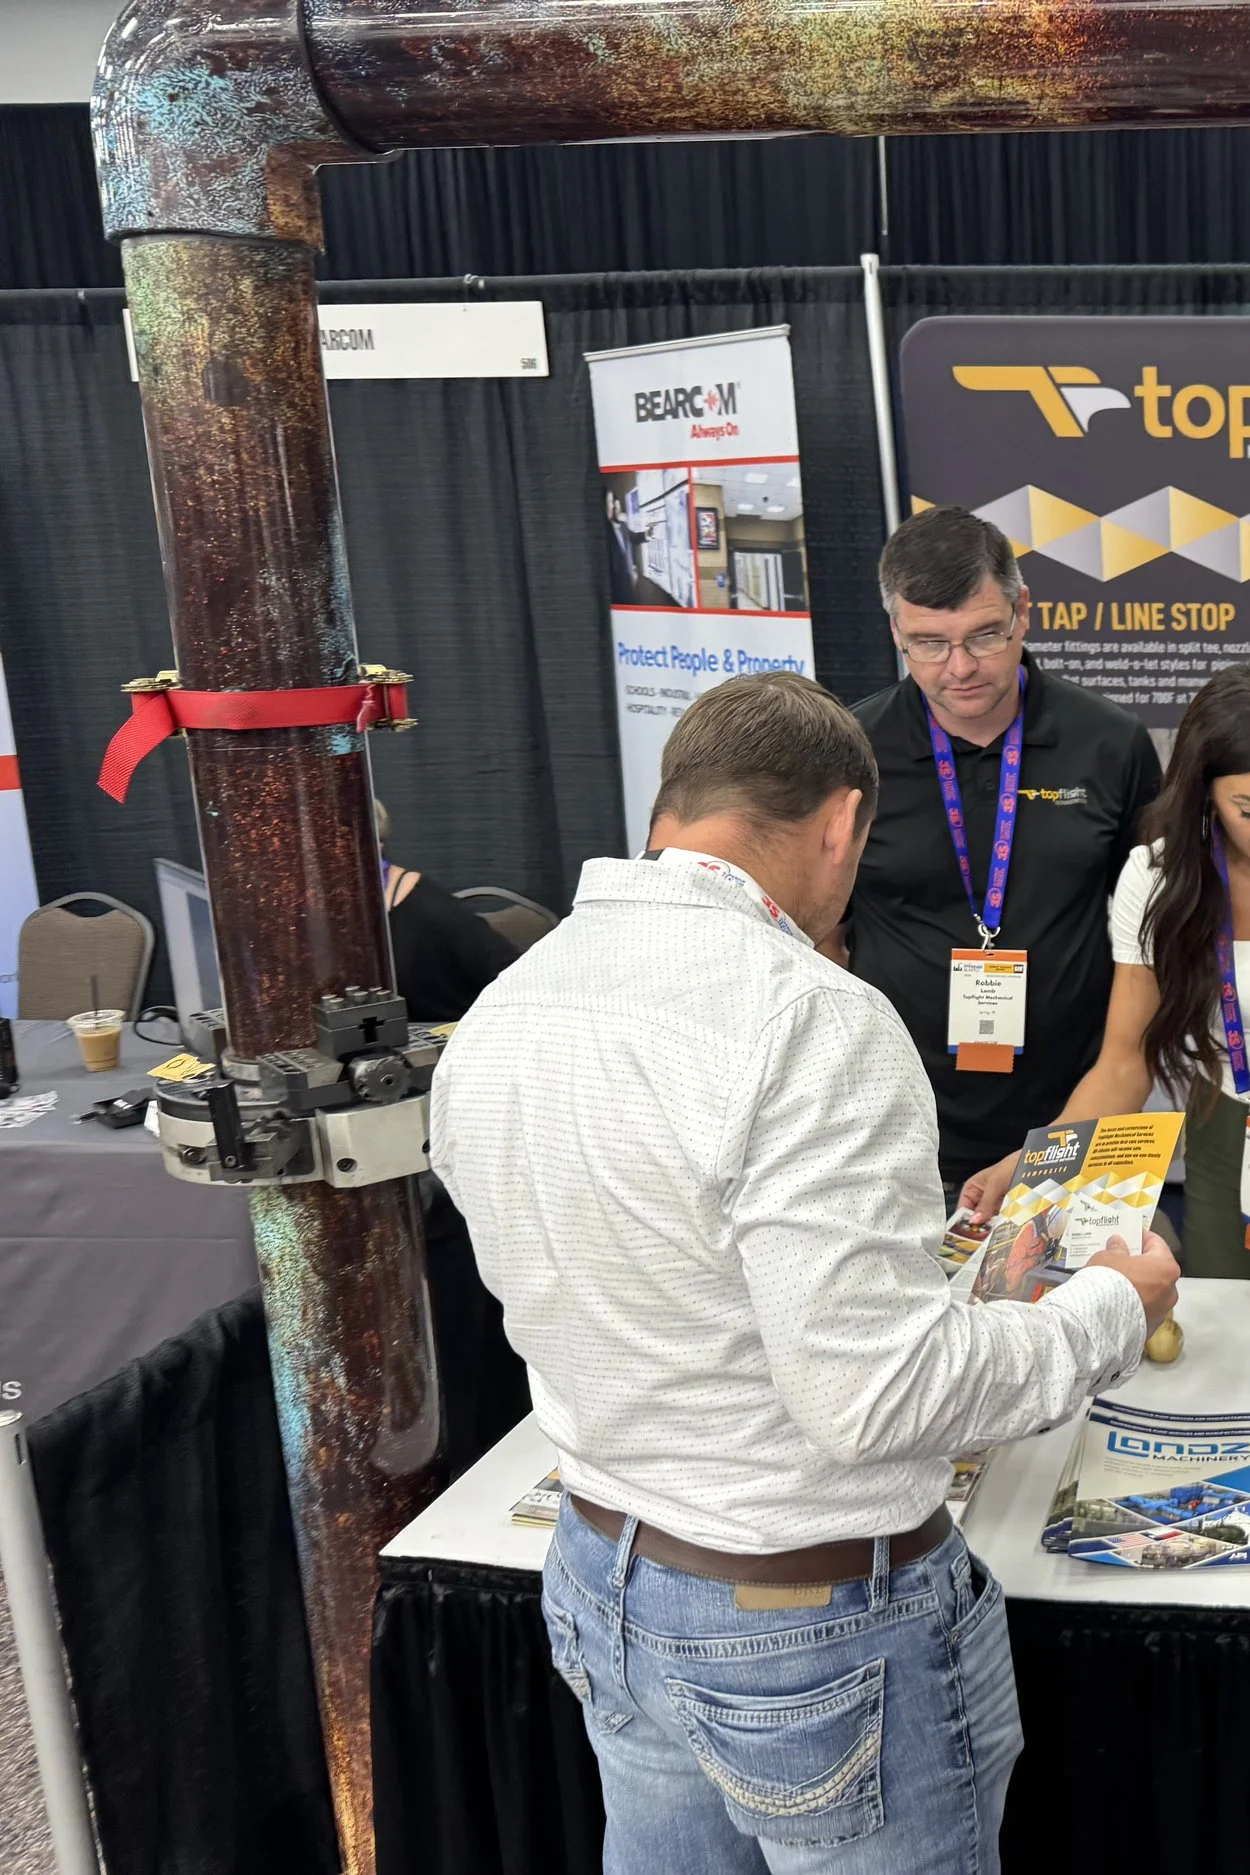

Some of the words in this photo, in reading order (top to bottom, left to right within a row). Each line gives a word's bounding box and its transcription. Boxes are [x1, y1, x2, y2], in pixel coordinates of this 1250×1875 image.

[321, 329, 376, 350] ARCOM
[690, 423, 724, 441] Always
[726, 422, 739, 436] On
[1037, 602, 1088, 631] TAP
[1094, 602, 1104, 631] /
[1111, 602, 1165, 631] LINE
[1171, 602, 1236, 631] STOP
[1064, 640, 1101, 656] fittings
[1102, 643, 1119, 654] are
[1120, 641, 1166, 654] available
[1178, 641, 1201, 657] split
[618, 642, 669, 669] Protect
[670, 645, 719, 677] People
[723, 648, 735, 673] &
[1084, 658, 1103, 671] and
[1160, 658, 1191, 674] styles
[1192, 658, 1207, 671] for
[1081, 674, 1127, 688] surfaces,
[1128, 675, 1156, 687] tanks
[1157, 676, 1176, 687] and
[1135, 692, 1150, 705] for
[975, 979, 1002, 987] Robbie
[1024, 1143, 1081, 1166] topflight
[1089, 1214, 1120, 1226] topflight
[1153, 1454, 1250, 1463] MACHINERY
